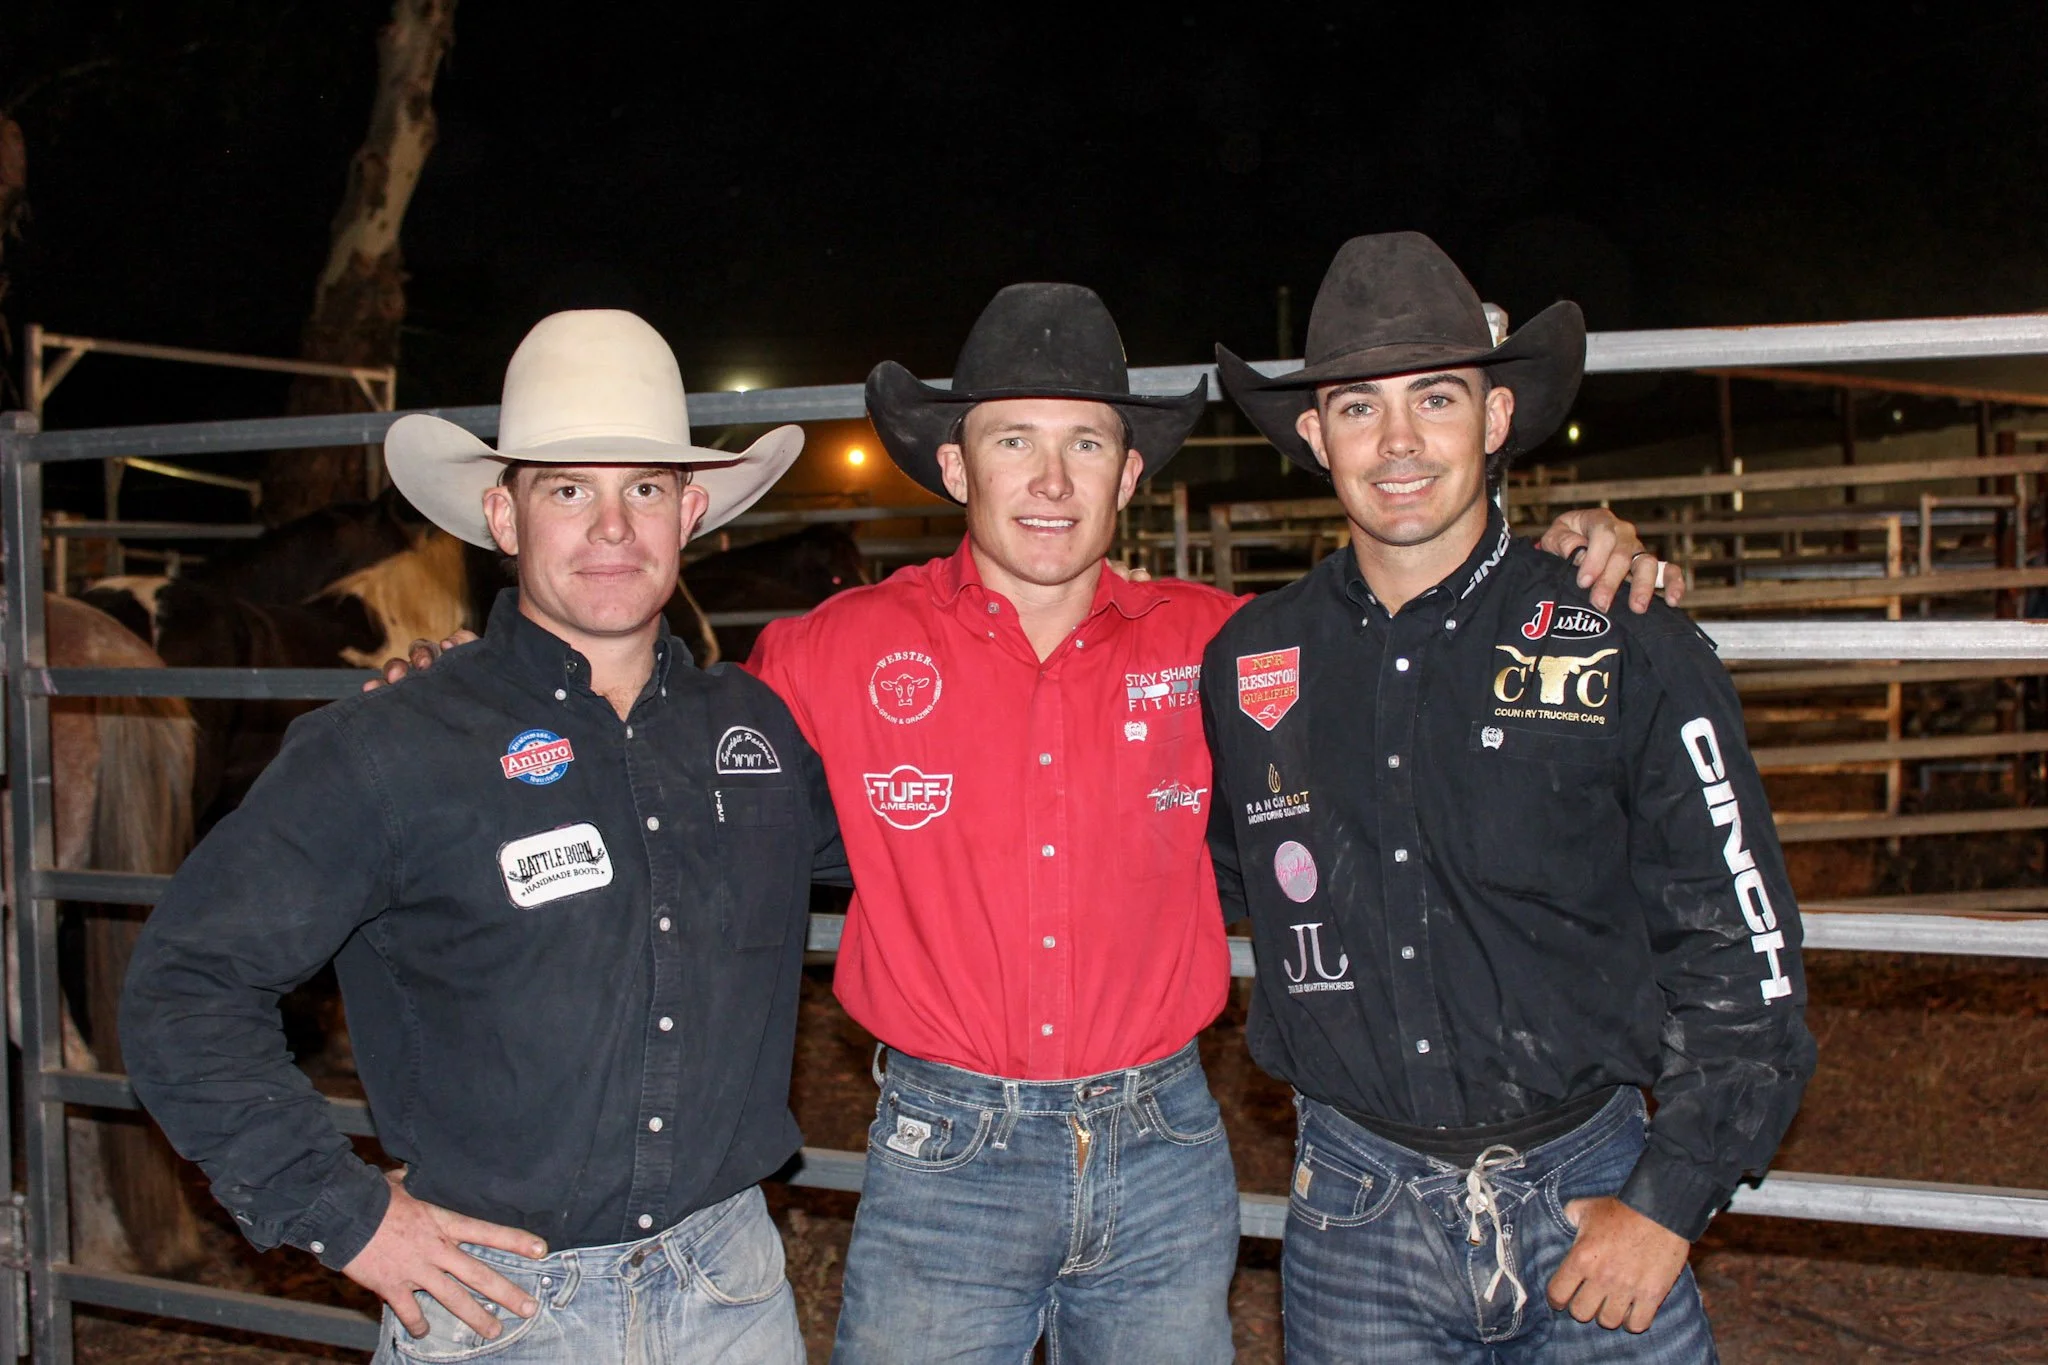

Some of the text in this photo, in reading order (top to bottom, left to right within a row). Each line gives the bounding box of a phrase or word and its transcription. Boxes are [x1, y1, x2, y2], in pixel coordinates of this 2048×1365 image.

[876, 651, 932, 669] WEBSTER
[1252, 653, 1285, 671] NFR
[1125, 672, 1157, 687] STAY
[1243, 685, 1297, 705] QUALIFIER
[878, 708, 898, 724] GRAIN
[1538, 709, 1580, 722] TRUCKER
[1580, 713, 1606, 725] CAPS
[508, 745, 570, 773] Anipro
[873, 781, 941, 803] TUFF
[714, 790, 725, 823] CINCH
[880, 802, 937, 811] AMERICA
[1246, 791, 1309, 815] RANCHBOT
[517, 840, 593, 878] BATTLE BORN
[1680, 716, 1793, 1000] CINCH
[524, 867, 600, 894] HANDMADE BOOTS
